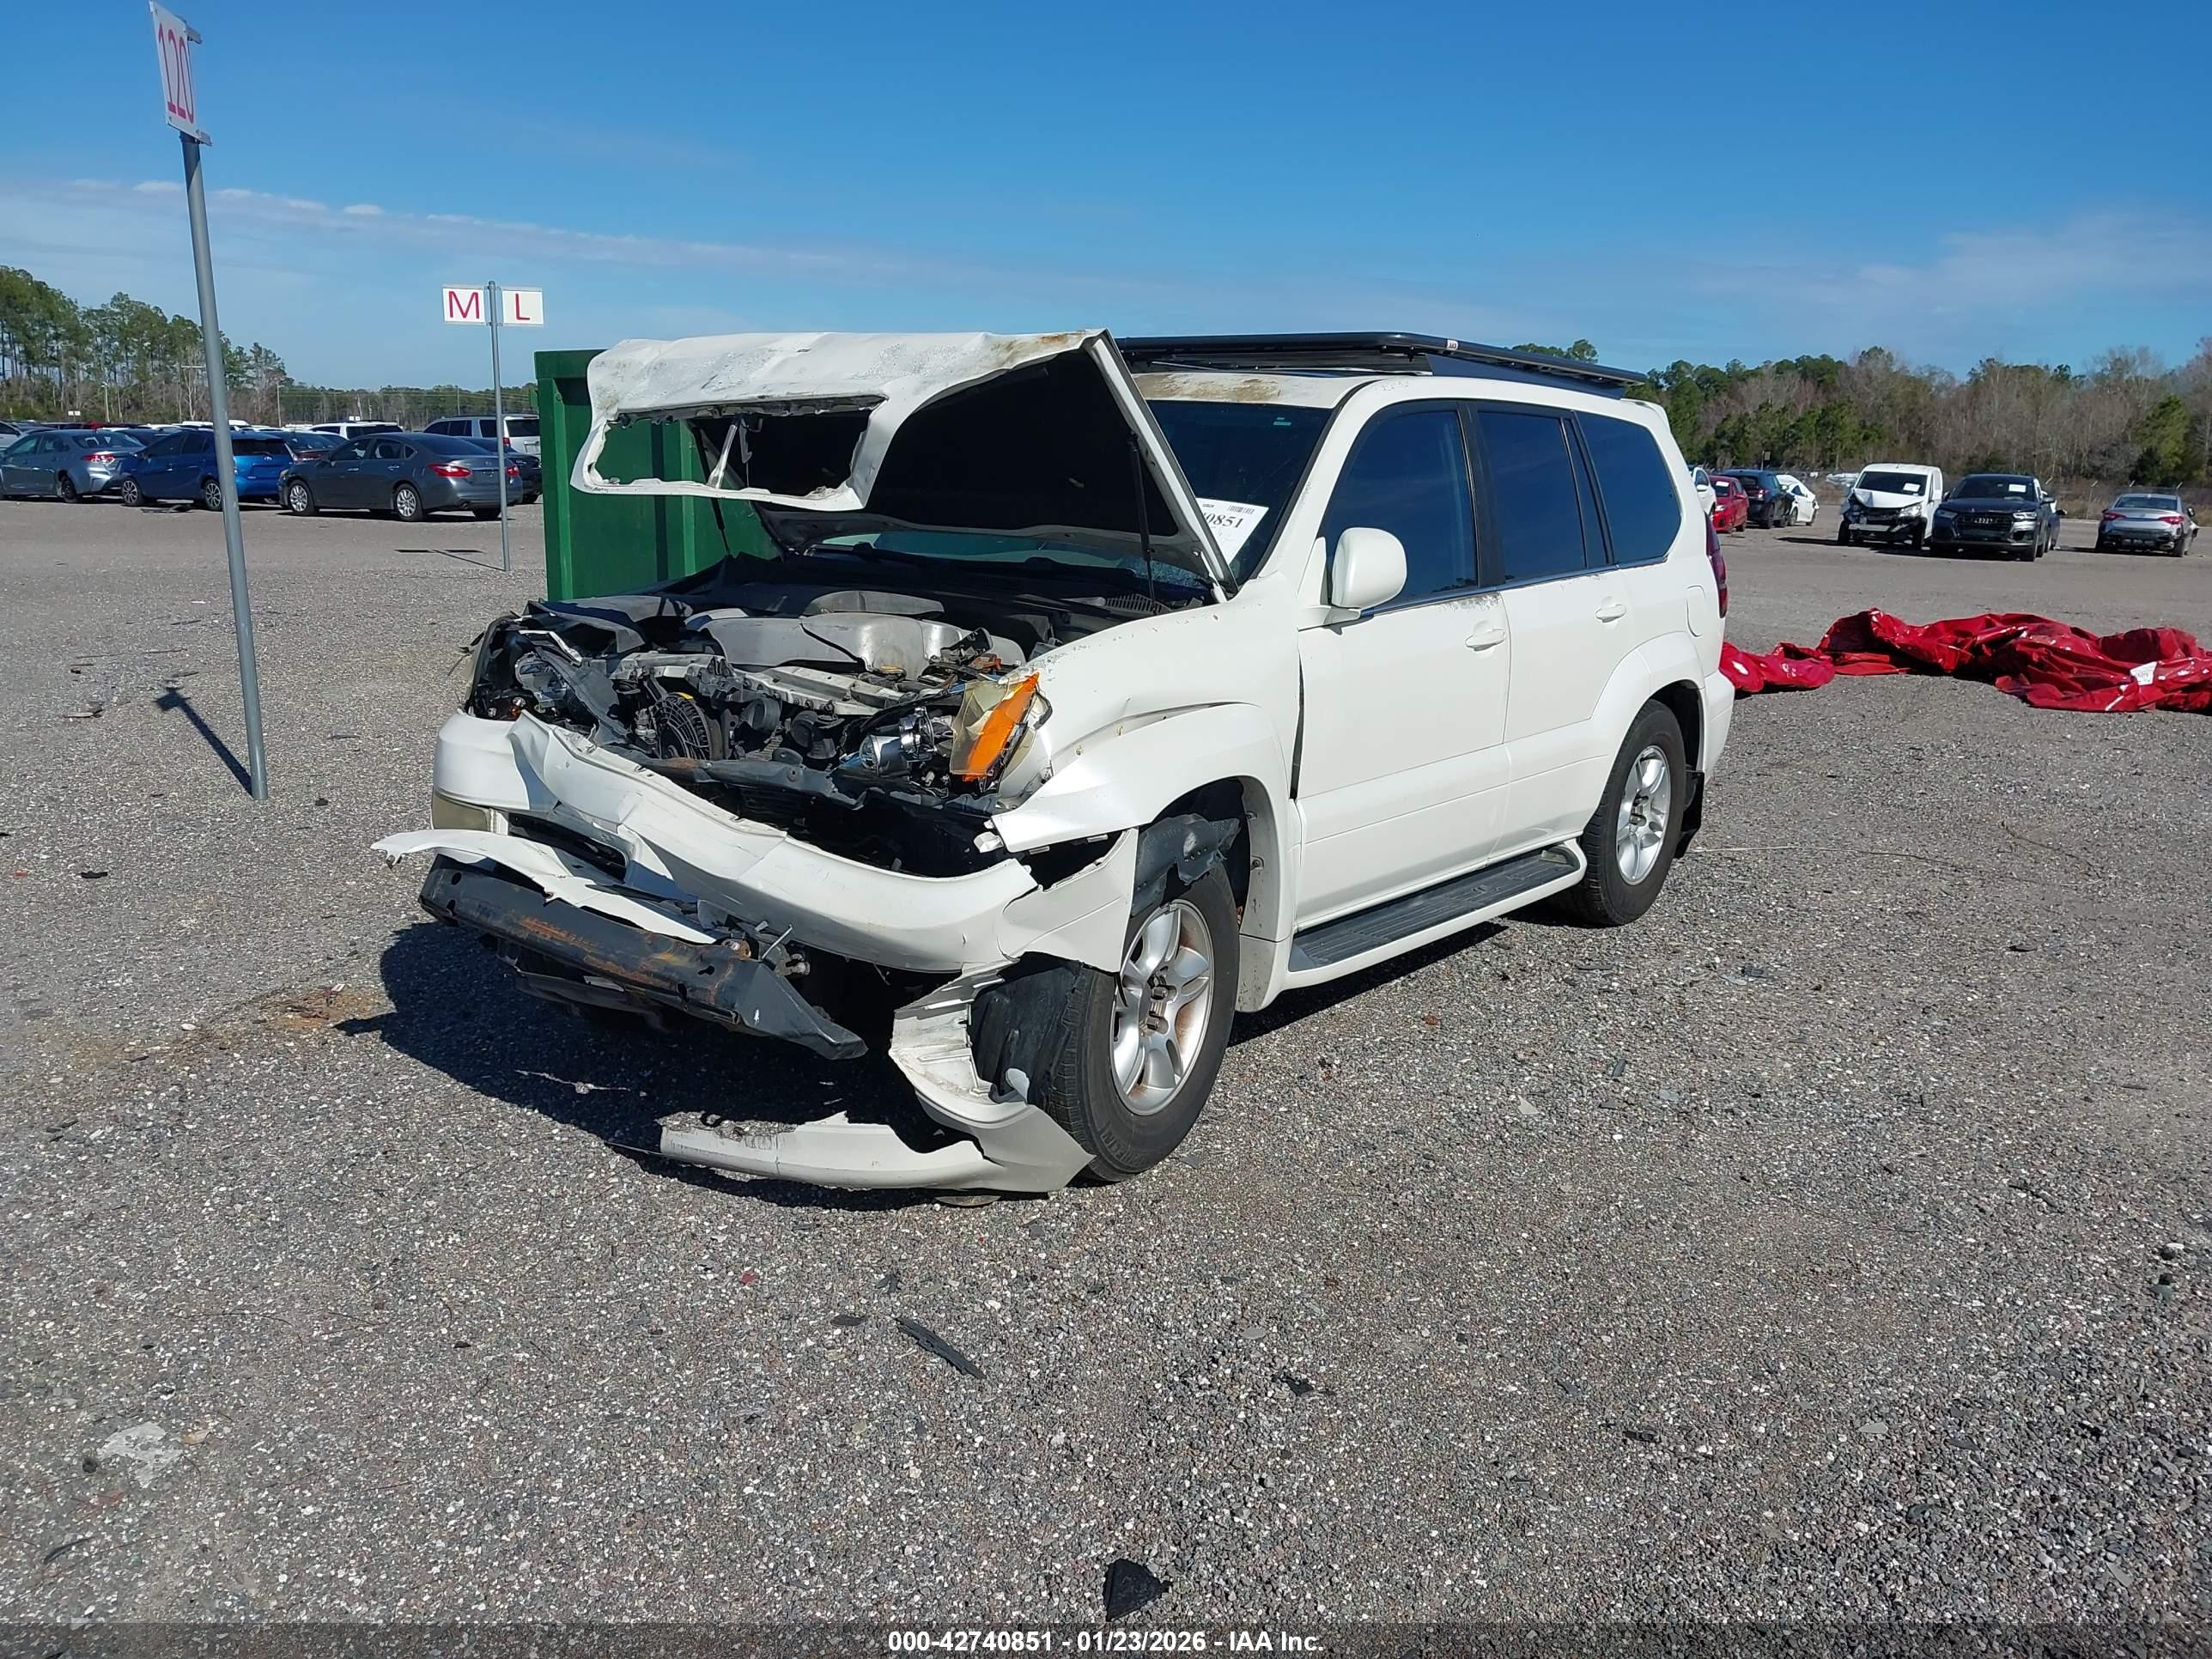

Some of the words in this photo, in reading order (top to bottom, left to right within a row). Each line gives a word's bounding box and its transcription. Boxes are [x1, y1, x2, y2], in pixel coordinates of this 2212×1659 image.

[158, 22, 194, 124] 120
[449, 291, 480, 319] M
[515, 293, 531, 320] L
[1203, 513, 1244, 528] 0851
